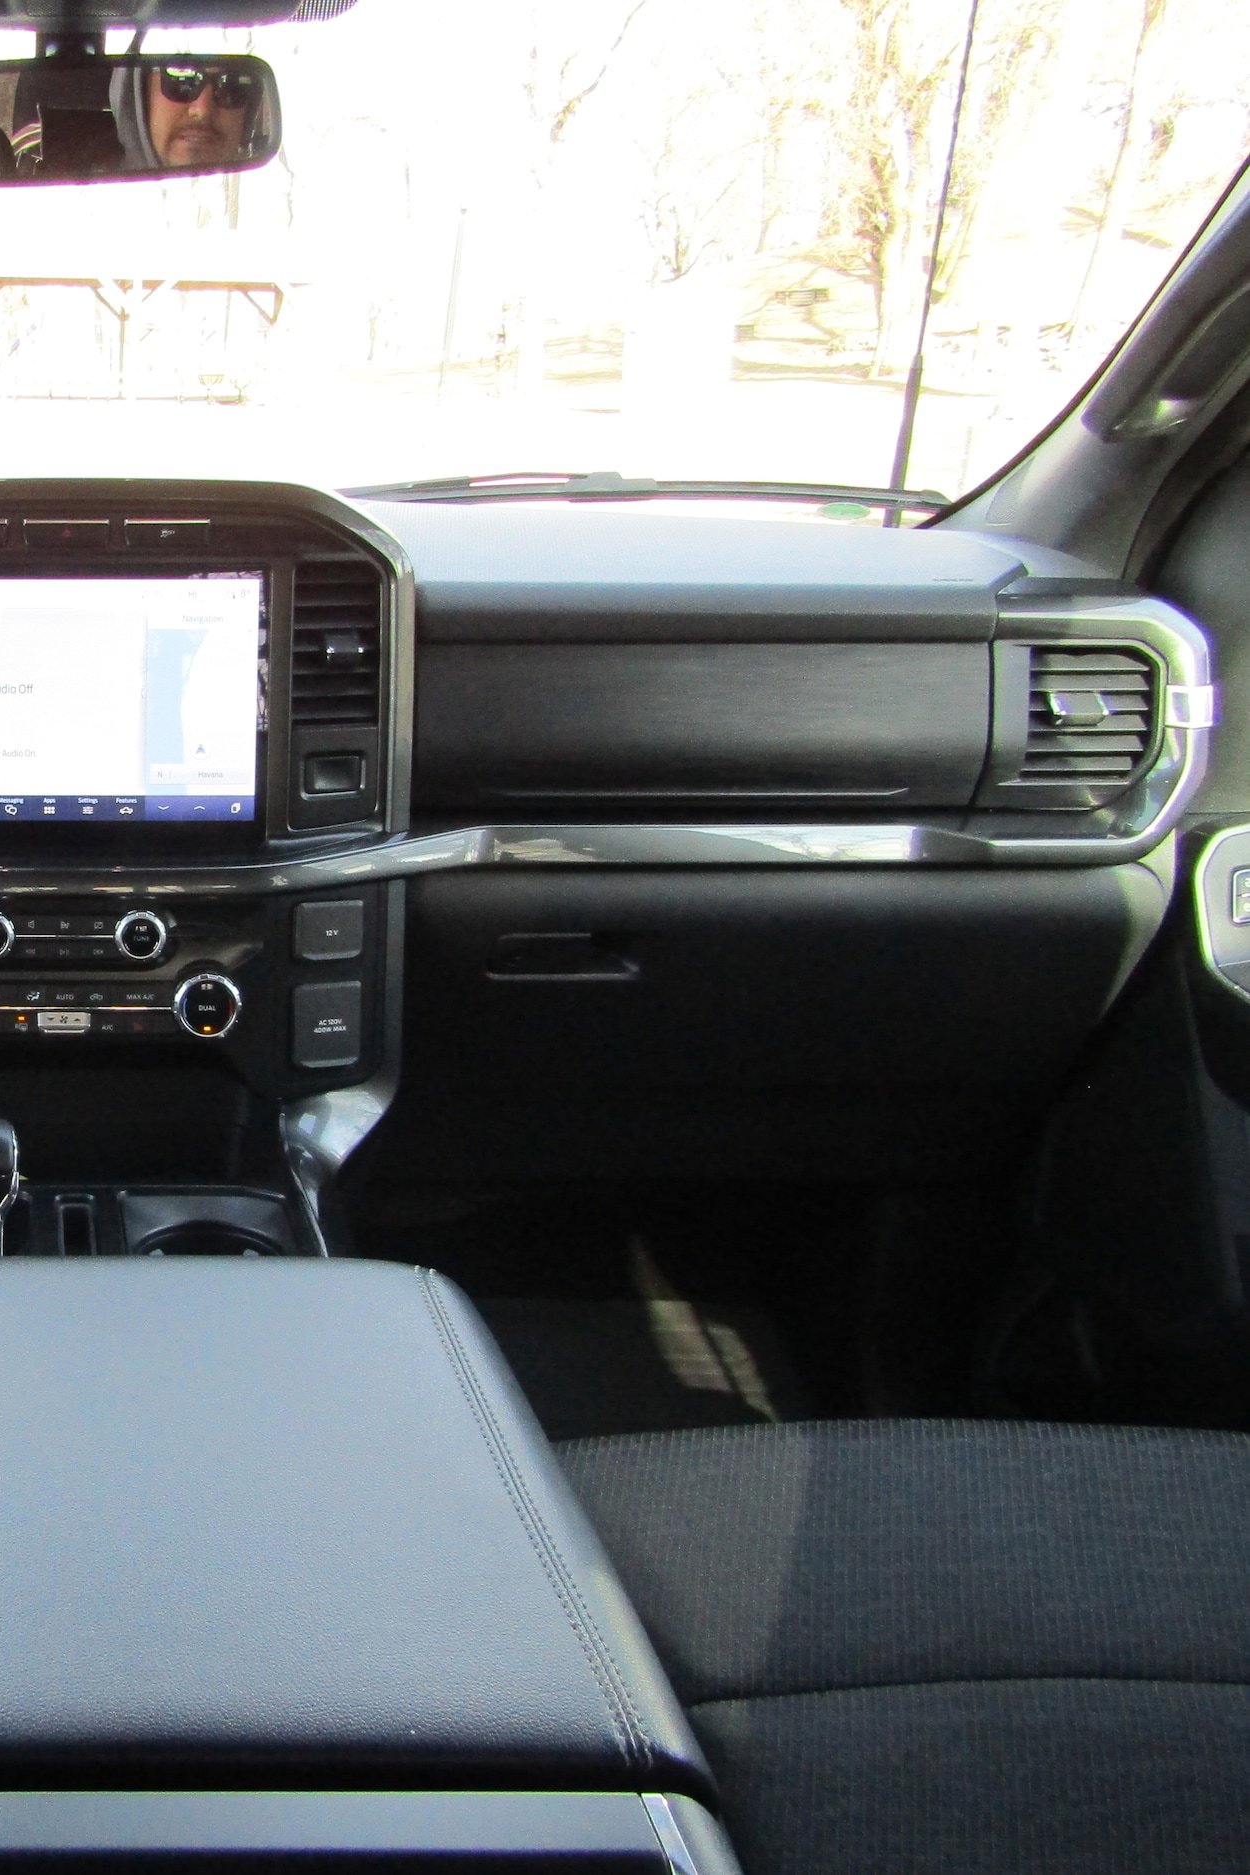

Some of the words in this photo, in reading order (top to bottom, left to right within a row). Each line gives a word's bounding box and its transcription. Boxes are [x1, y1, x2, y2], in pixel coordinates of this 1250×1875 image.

[18, 684, 34, 694] Off
[2, 748, 24, 758] Audio
[24, 748, 36, 758] On
